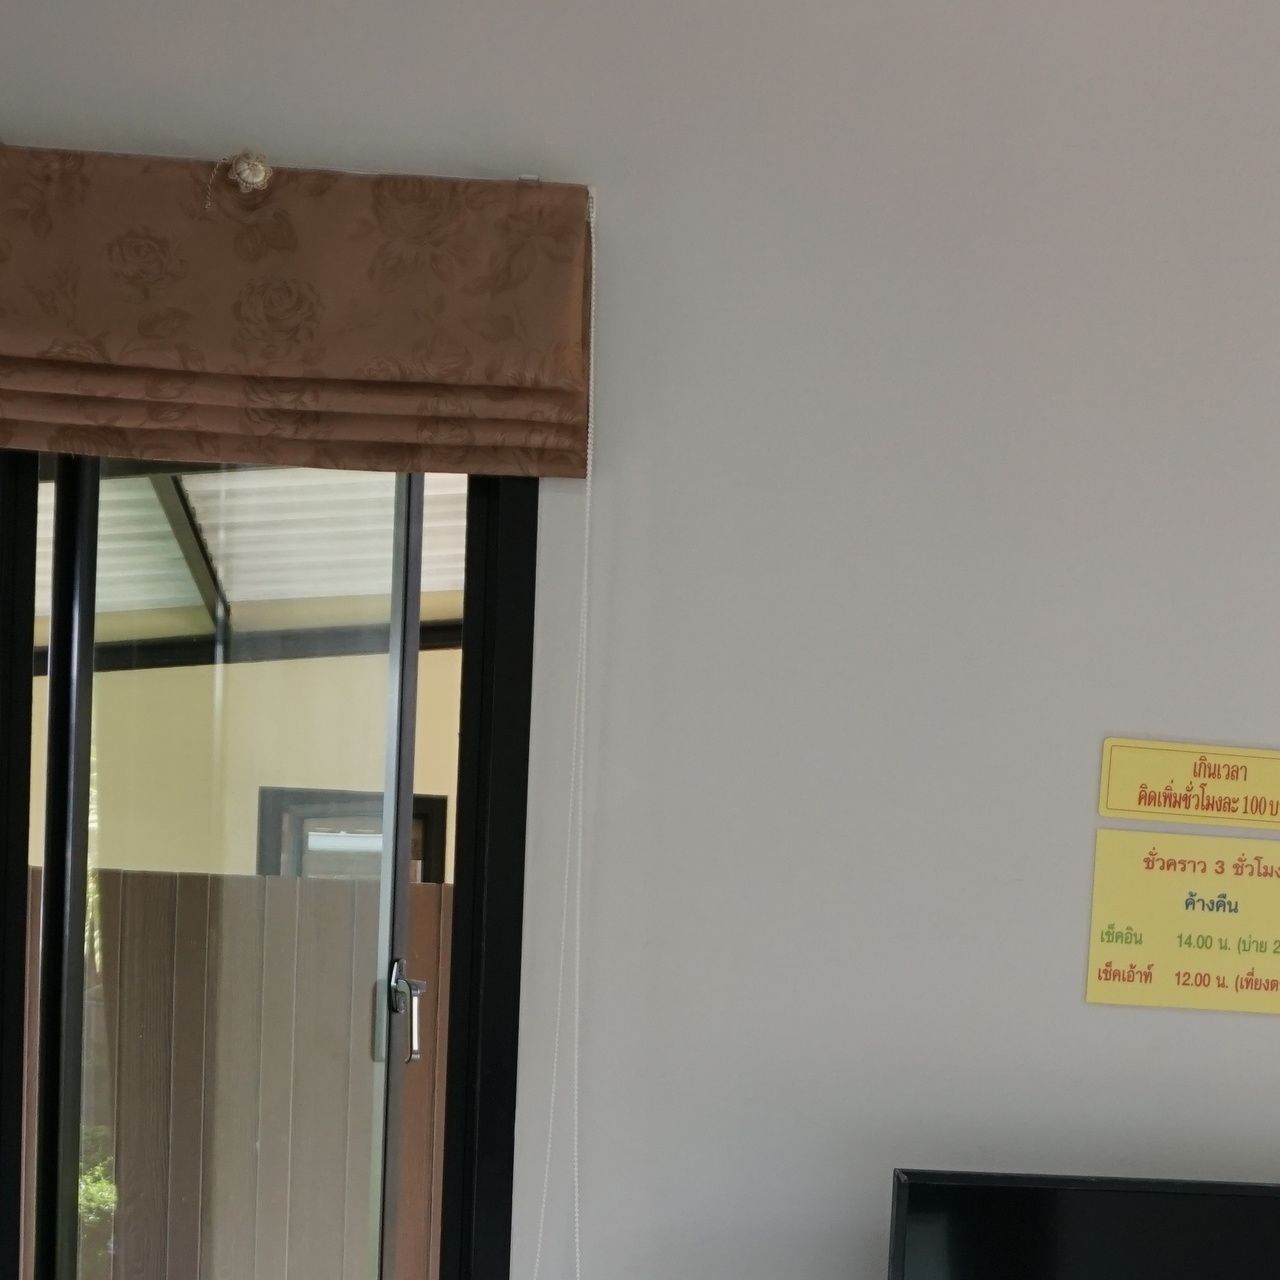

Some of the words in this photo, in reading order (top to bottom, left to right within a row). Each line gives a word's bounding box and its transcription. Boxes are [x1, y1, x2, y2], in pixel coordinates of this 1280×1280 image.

[1193, 755, 1248, 782] เกินเวลา
[1137, 780, 1240, 813] คิดเพิ่มชั่วโมงละ
[1243, 795, 1267, 815] 100
[1143, 847, 1207, 874] ชั่วคราว
[1214, 860, 1225, 875] 3
[1185, 891, 1239, 914] ค้างคืน
[1100, 923, 1143, 945] เช็คอิน
[1177, 933, 1213, 950] 14.00
[1217, 937, 1231, 951] น.
[1237, 934, 1268, 955] (บ่าย
[1097, 961, 1155, 984] เช็คเอ้าท์
[1175, 971, 1211, 988] 12.00
[1216, 975, 1229, 989] น.
